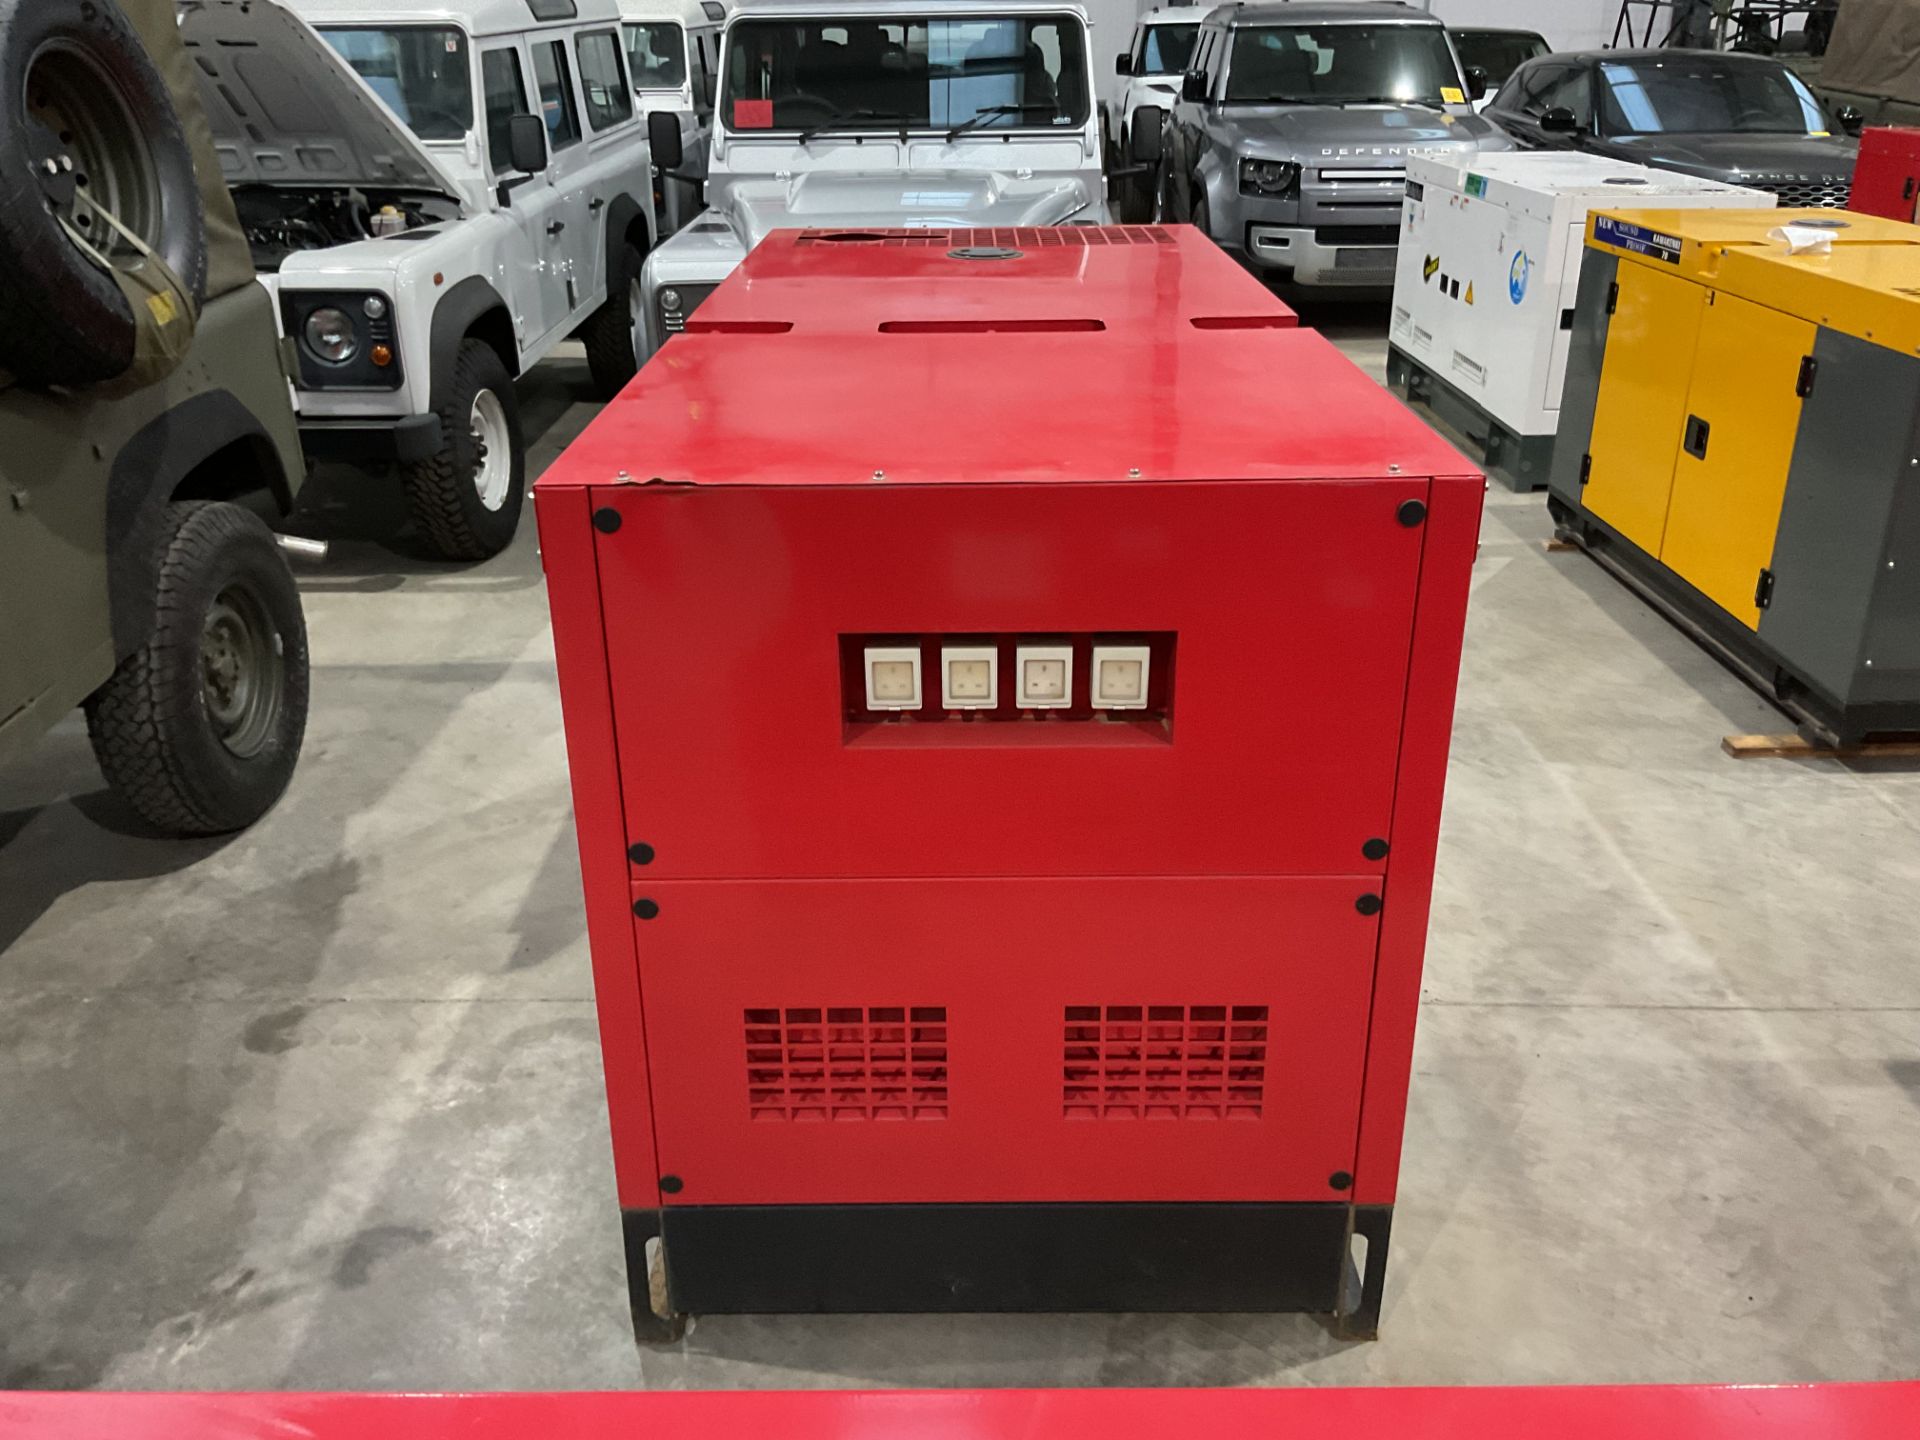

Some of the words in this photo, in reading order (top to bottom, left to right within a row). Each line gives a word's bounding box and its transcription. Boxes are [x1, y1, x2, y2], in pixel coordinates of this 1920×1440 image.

[1321, 147, 1450, 156] DEFENDER
[1740, 173, 1809, 181] RANGE
[1598, 216, 1614, 231] NEW
[1619, 222, 1639, 236] SOUND
[1626, 239, 1647, 253] PROOF
